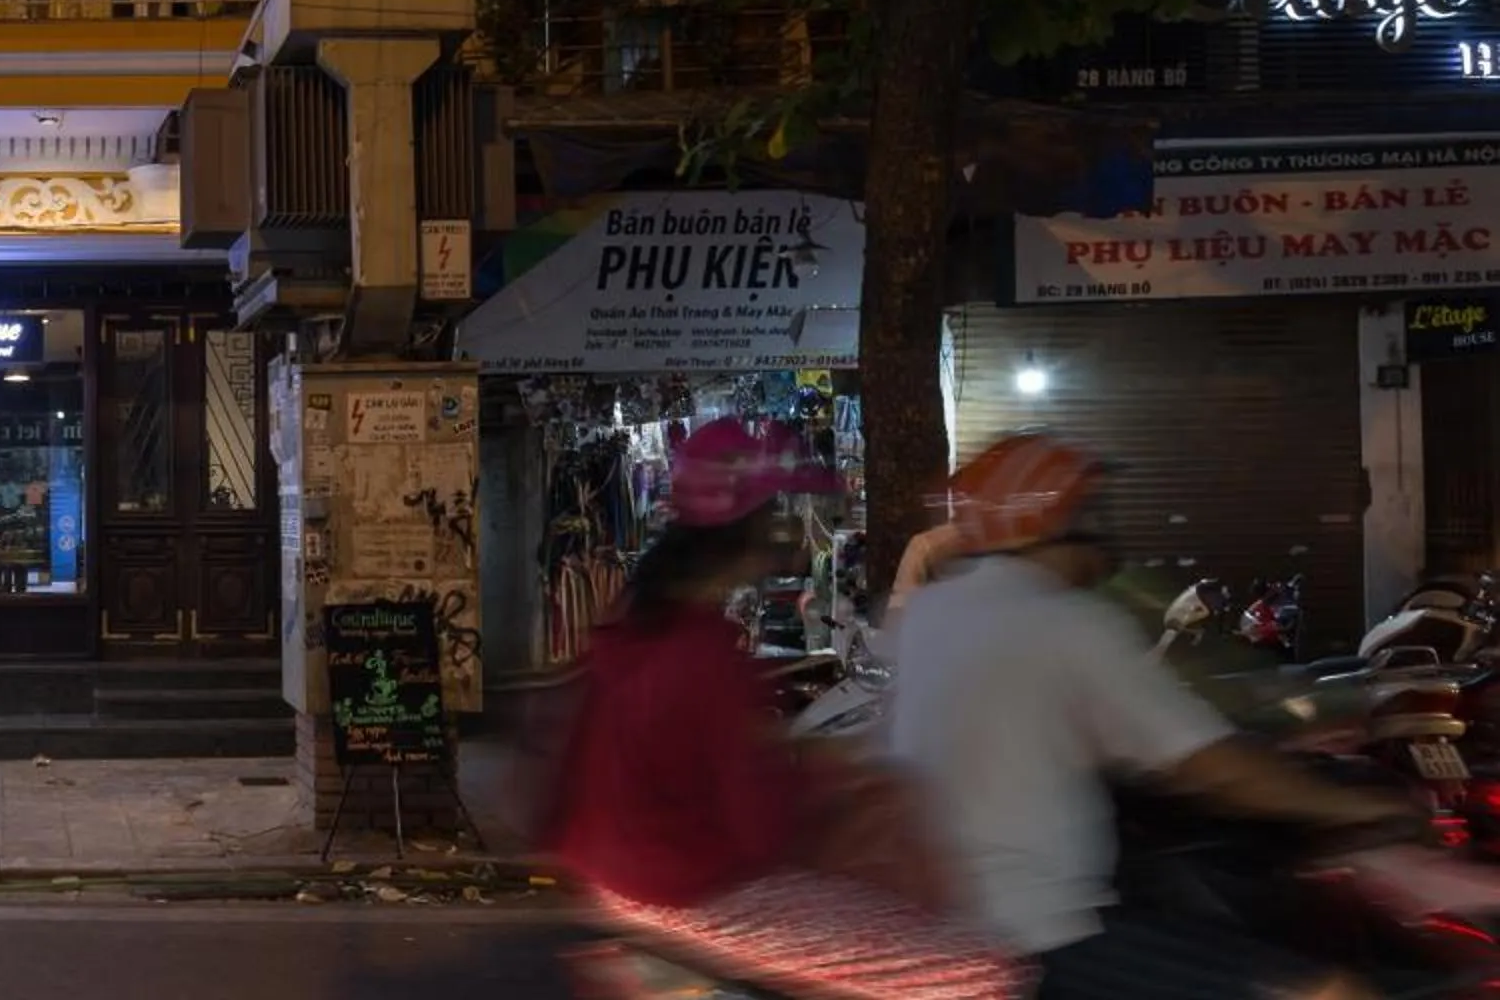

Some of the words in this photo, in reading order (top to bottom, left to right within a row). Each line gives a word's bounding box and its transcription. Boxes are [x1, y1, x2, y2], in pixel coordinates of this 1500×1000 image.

[1189, 156, 1253, 172] CÔNG
[1259, 154, 1282, 169] TY
[1179, 188, 1288, 217] BUÔN
[1324, 184, 1409, 212] BÁN
[1422, 178, 1470, 208] LẺ
[606, 209, 655, 236] Bán
[663, 208, 727, 236] buôn
[734, 207, 781, 236] bán
[1066, 239, 1153, 270] PHỤ
[1168, 230, 1266, 266] LIỆU
[1281, 230, 1380, 259] MAY
[1393, 221, 1492, 260] MẶC
[597, 244, 691, 301] PHỤ
